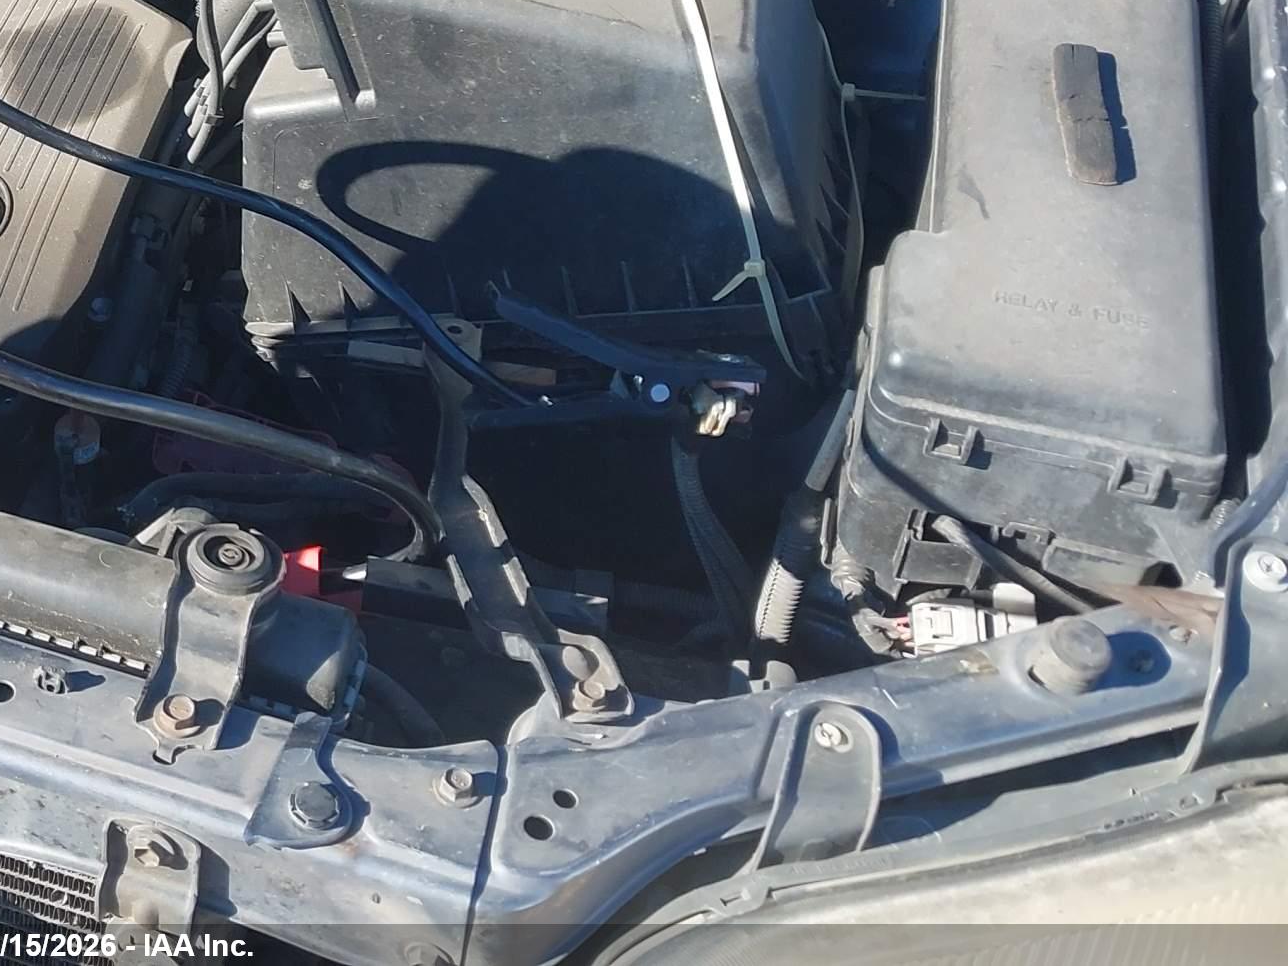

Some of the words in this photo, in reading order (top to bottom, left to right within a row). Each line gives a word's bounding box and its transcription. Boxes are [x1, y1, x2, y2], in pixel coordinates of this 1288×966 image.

[994, 290, 1059, 313] RELAY
[1067, 303, 1082, 318] &
[1093, 307, 1150, 330] FUSE
